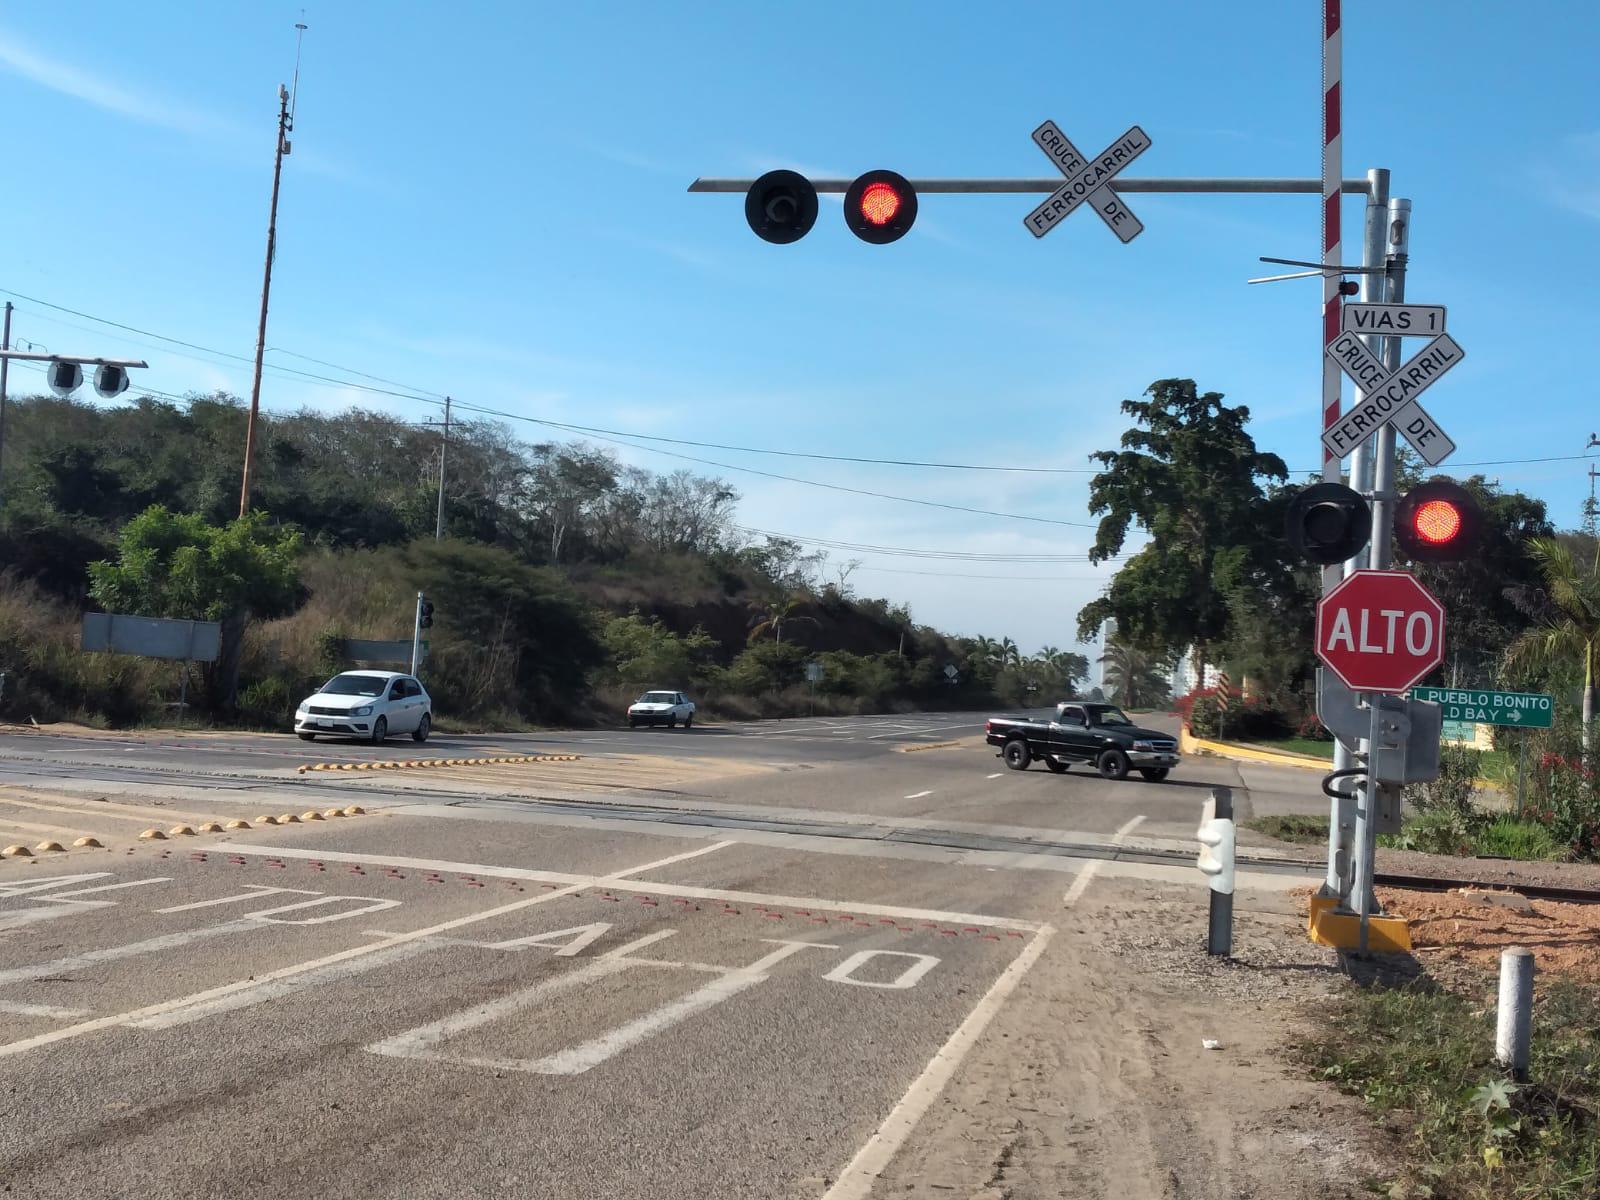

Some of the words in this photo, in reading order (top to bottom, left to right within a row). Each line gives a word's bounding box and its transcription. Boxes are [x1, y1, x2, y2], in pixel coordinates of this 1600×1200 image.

[1040, 129, 1081, 173] CRUCE
[1033, 139, 1143, 229] FERROCARRIL
[1103, 201, 1127, 226] DE
[1354, 310, 1411, 329] VIAS
[1428, 312, 1436, 330] 1
[1335, 338, 1384, 389] CRUCE
[1331, 348, 1454, 449] FERROCARRIL
[1406, 418, 1436, 447] DE
[1326, 607, 1434, 656] ALTO
[1428, 690, 1489, 706] PUEBLO
[1493, 695, 1550, 710] BONITO
[1465, 708, 1500, 721] BAY
[484, 922, 941, 988] ALTO
